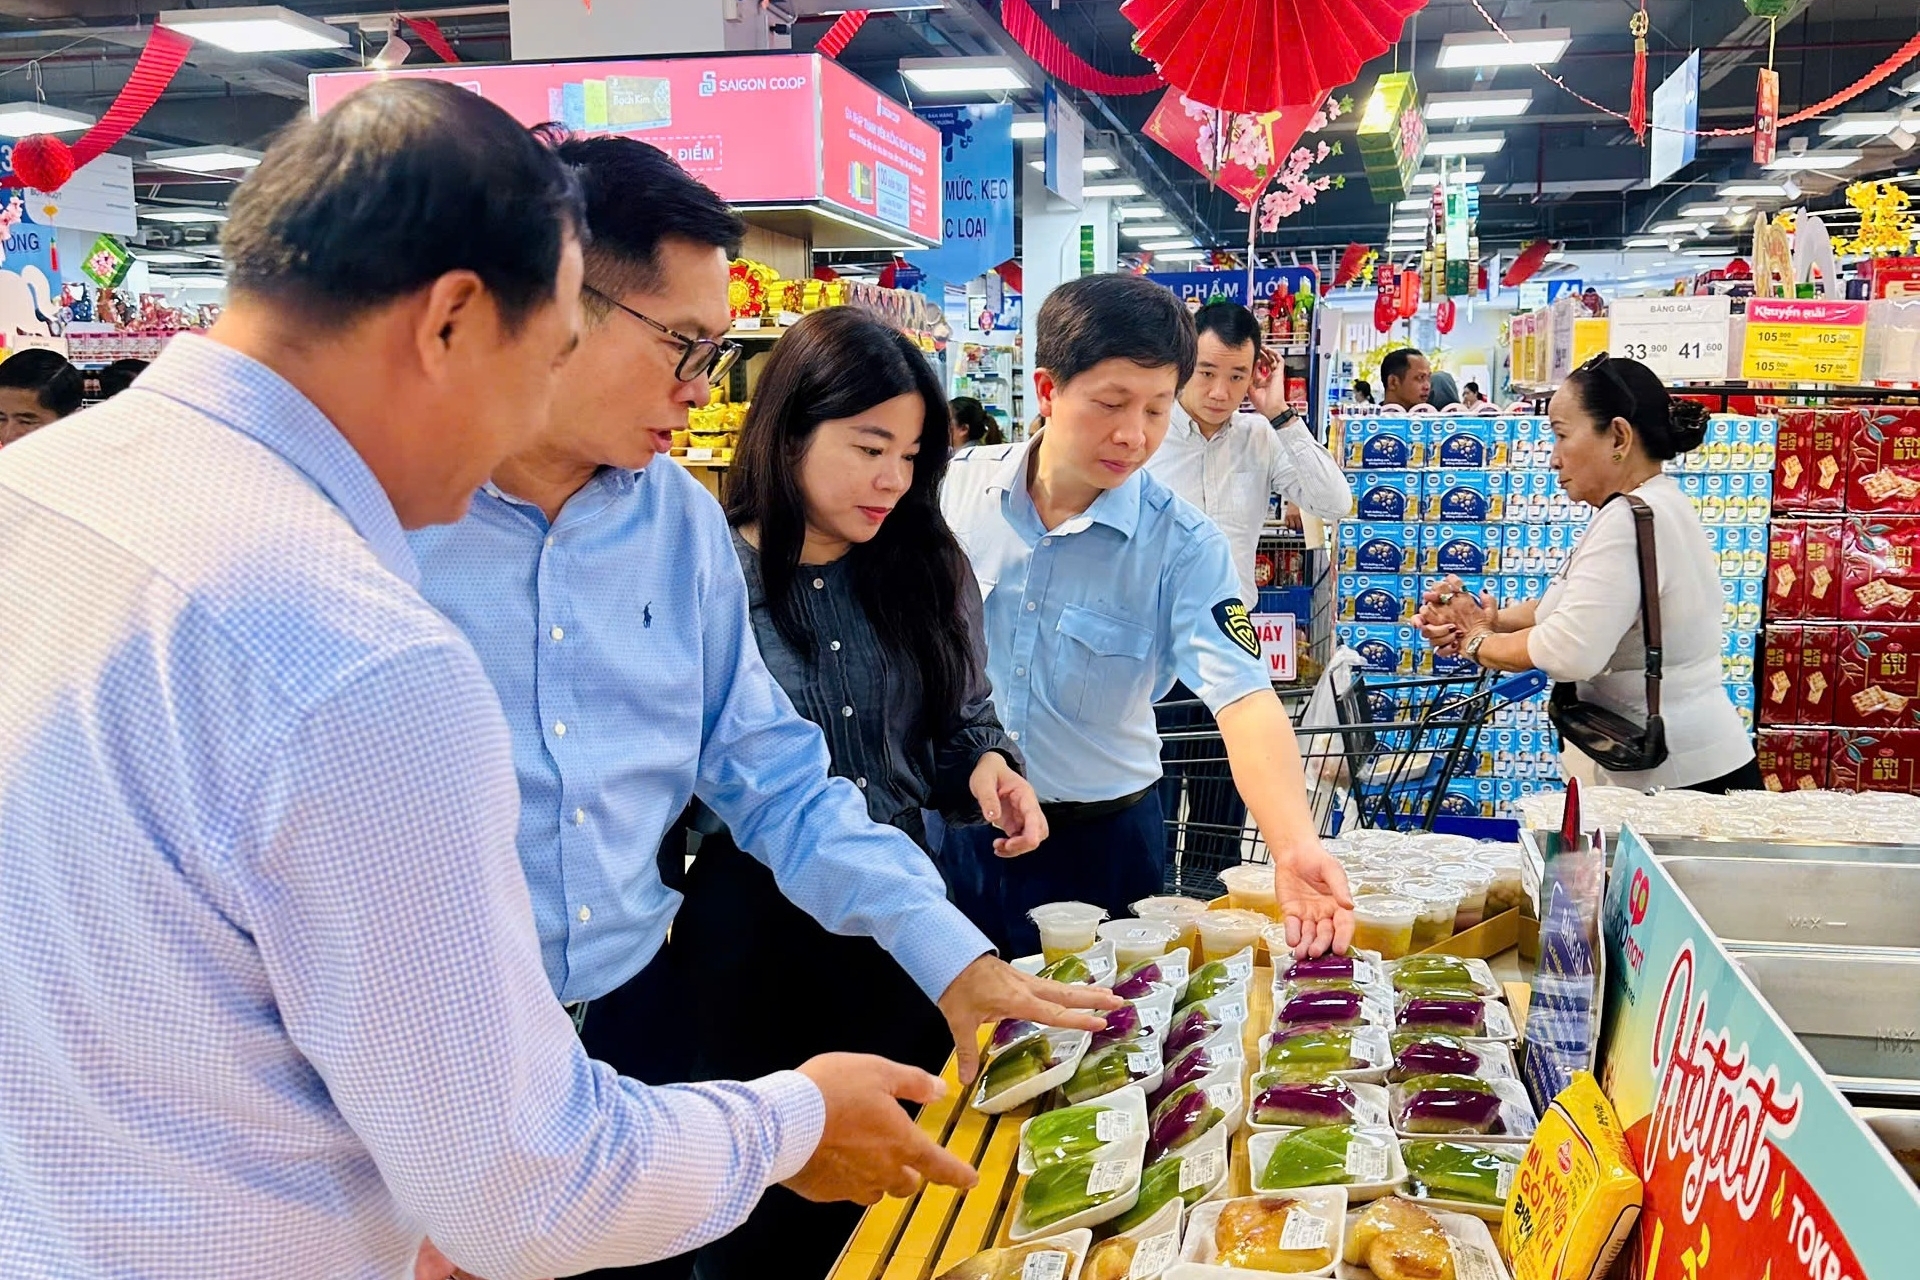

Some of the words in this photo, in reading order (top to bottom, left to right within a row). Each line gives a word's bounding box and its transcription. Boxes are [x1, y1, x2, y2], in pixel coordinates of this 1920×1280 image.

[719, 78, 767, 92] SAIGON
[769, 76, 806, 91] CO.OP
[677, 141, 714, 161] ĐIỂM
[981, 178, 1008, 204] KẸO
[957, 217, 987, 242] LOẠI
[1181, 276, 1239, 299] PHẨM
[1758, 331, 1778, 342] 105
[1817, 333, 1837, 344] 105
[1623, 343, 1647, 360] 33
[1678, 342, 1700, 359] 41
[1755, 361, 1775, 371] 105
[1814, 363, 1834, 374] 157
[1270, 653, 1286, 674] VỊ
[1881, 652, 1907, 664] KEN
[1872, 757, 1899, 769] KEN
